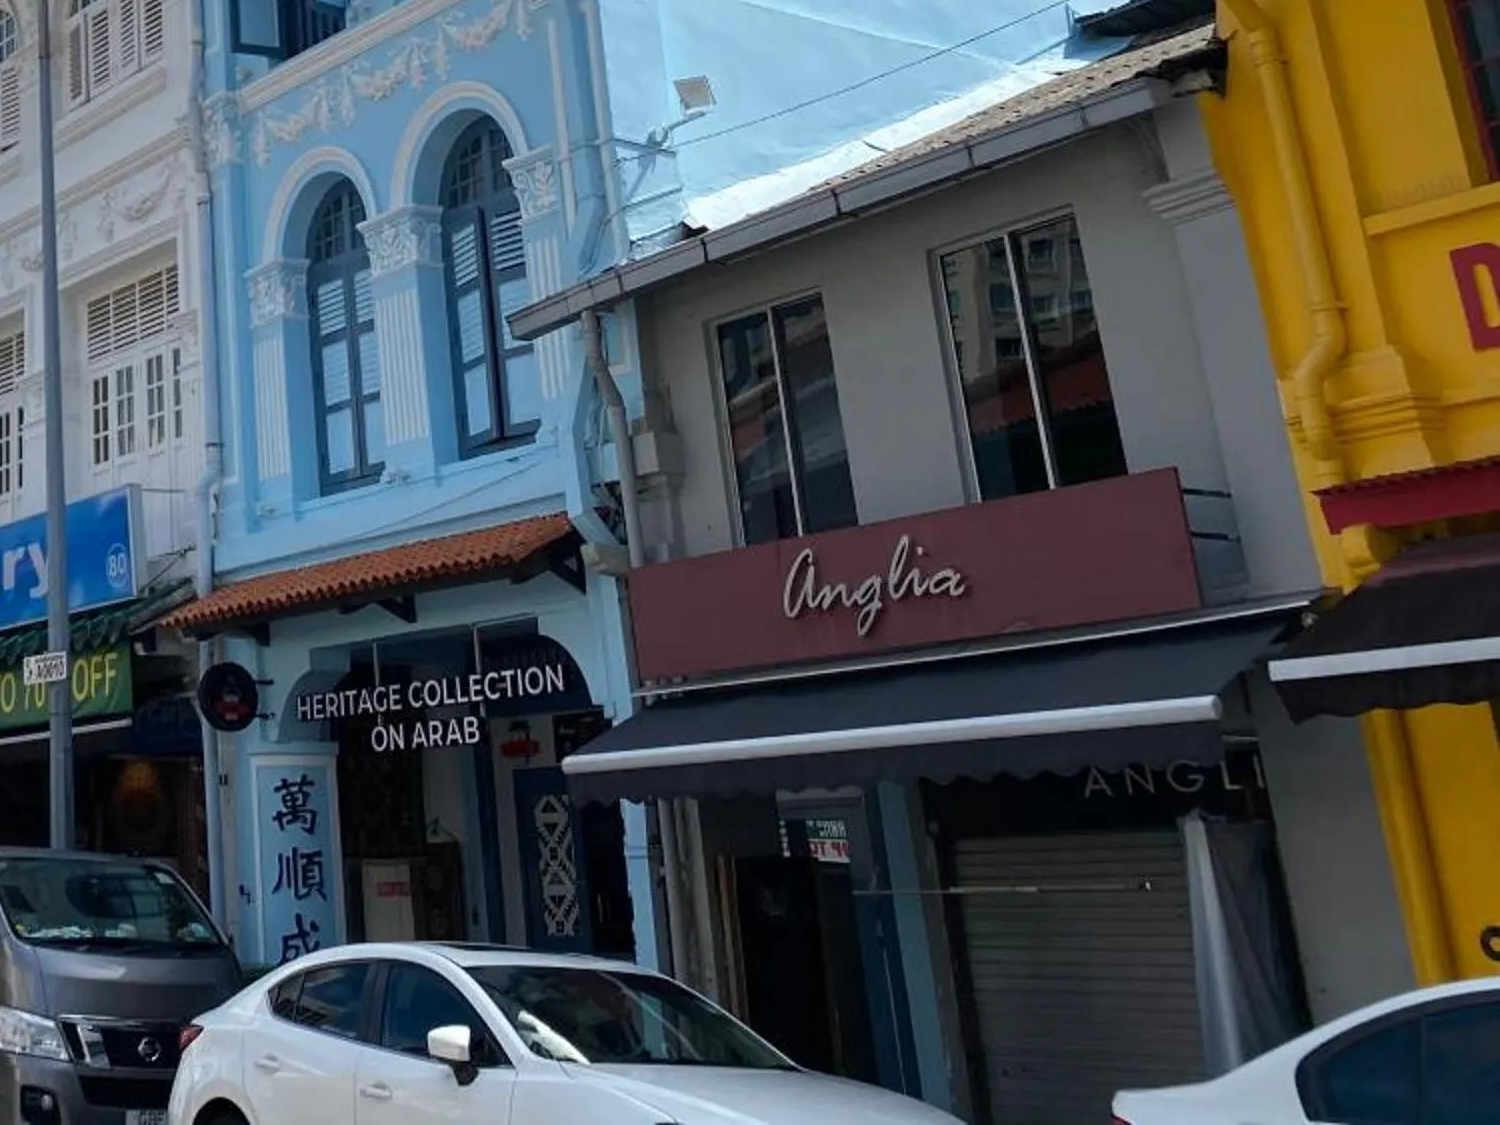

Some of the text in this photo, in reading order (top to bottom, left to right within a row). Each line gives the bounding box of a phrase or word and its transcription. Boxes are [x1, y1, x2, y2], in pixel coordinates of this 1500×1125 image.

[783, 534, 967, 637] Anglia
[72, 652, 119, 700] OFF
[296, 663, 566, 721] HERITAGE COLLECTION
[371, 716, 481, 753] ON ARAB
